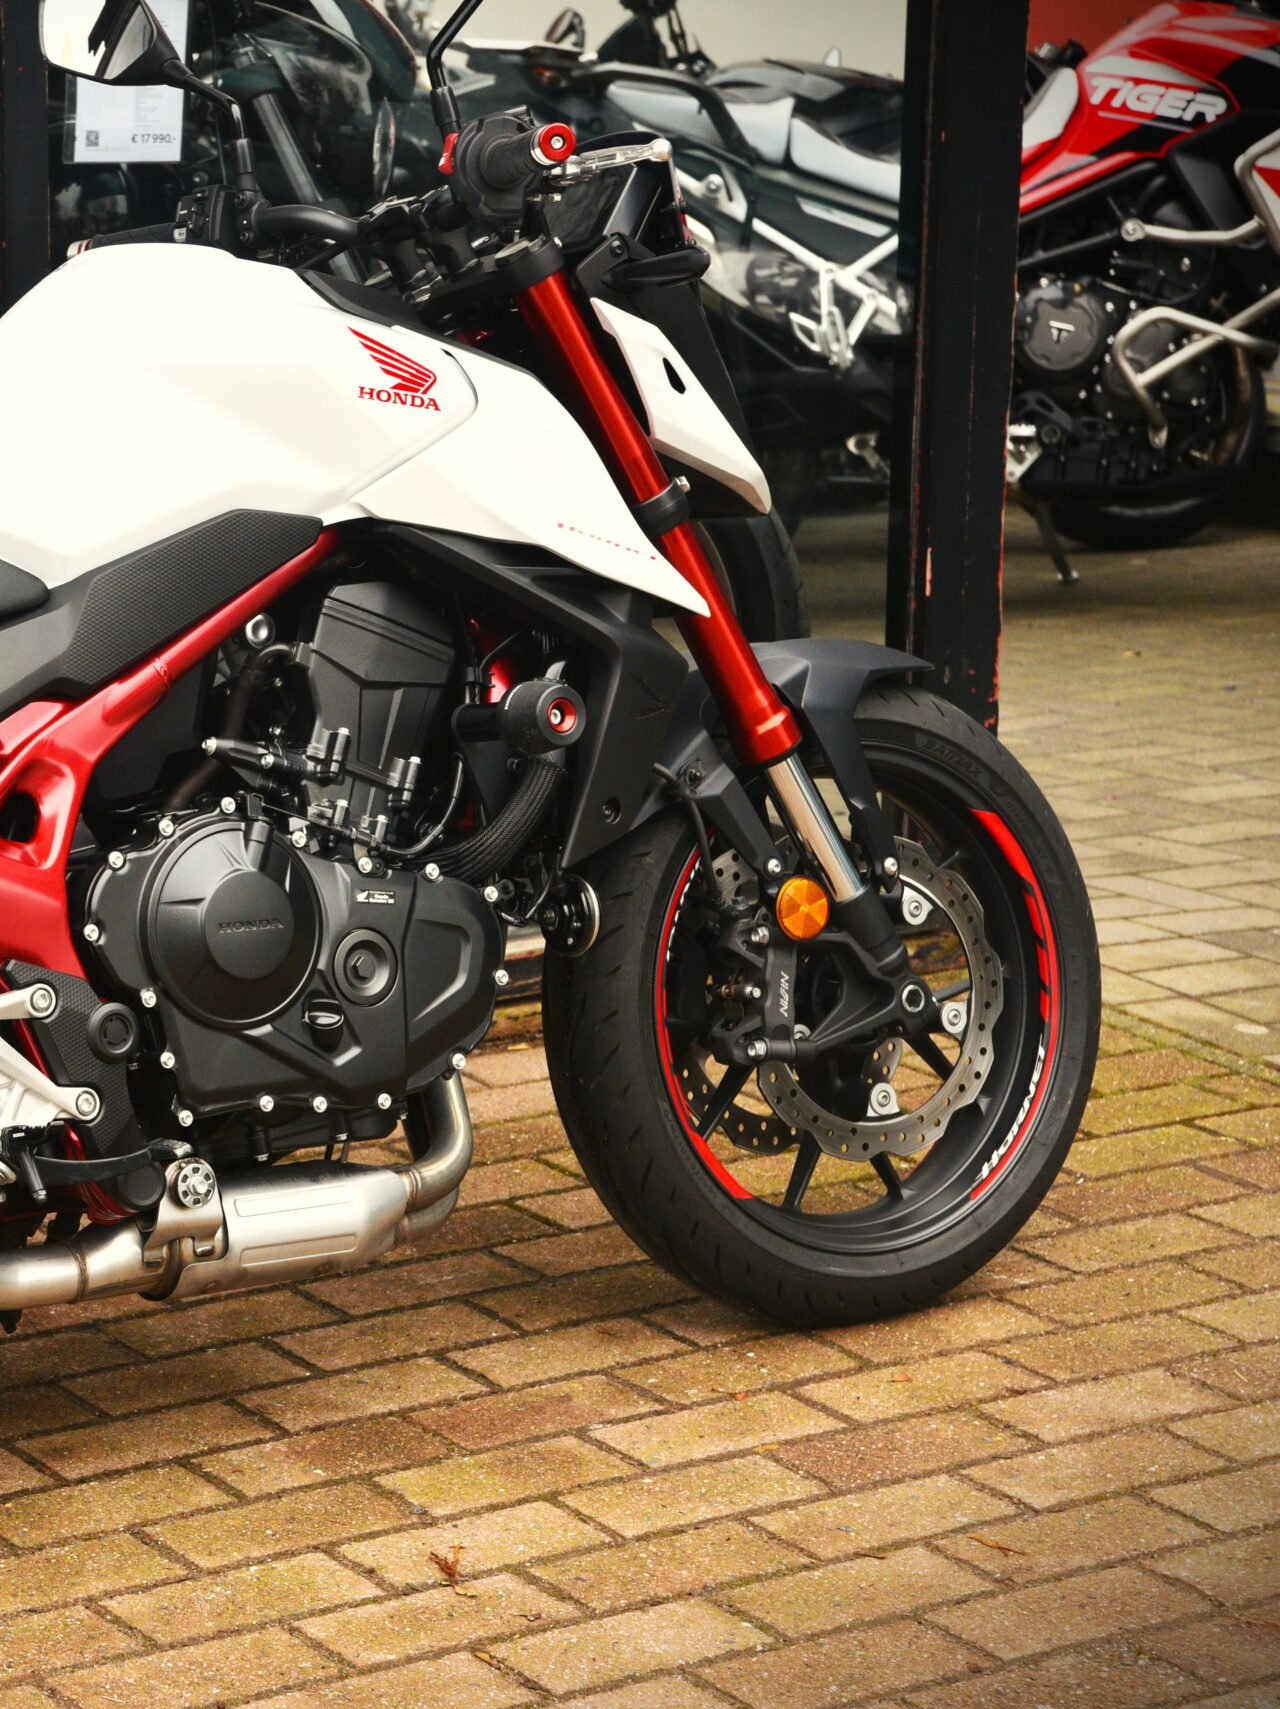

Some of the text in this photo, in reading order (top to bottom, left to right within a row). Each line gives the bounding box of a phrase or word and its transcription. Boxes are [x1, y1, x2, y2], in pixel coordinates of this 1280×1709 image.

[1089, 77, 1228, 123] TIGER
[357, 385, 442, 412] HONDA
[218, 918, 285, 934] HONDA
